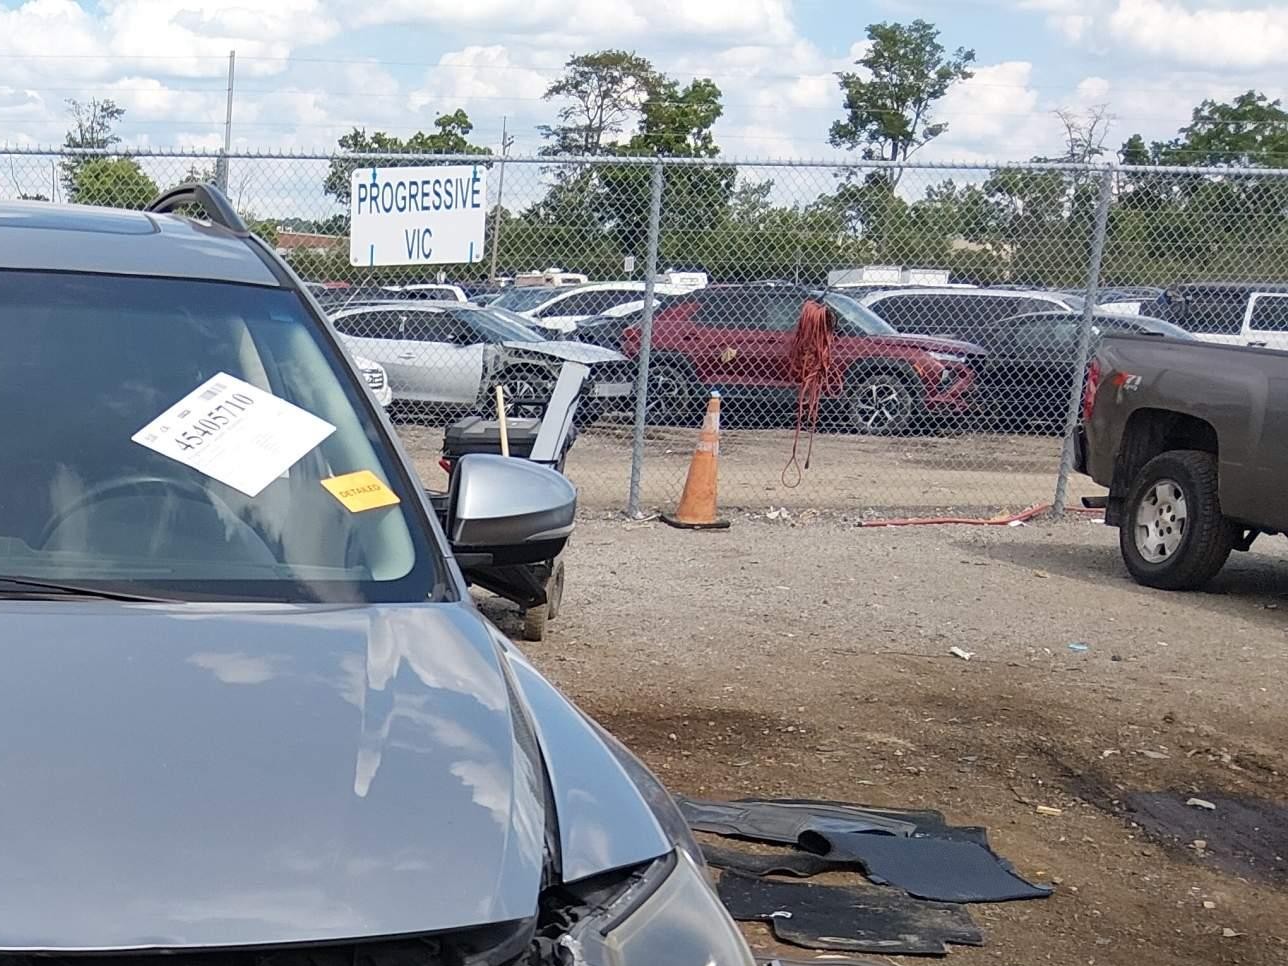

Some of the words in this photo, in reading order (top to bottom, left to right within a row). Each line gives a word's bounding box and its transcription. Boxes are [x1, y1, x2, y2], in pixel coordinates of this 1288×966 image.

[357, 177, 481, 215] PROGRESSIVE
[405, 228, 433, 260] VIC
[174, 393, 254, 451] 45405710
[339, 484, 381, 498] DETAILED
